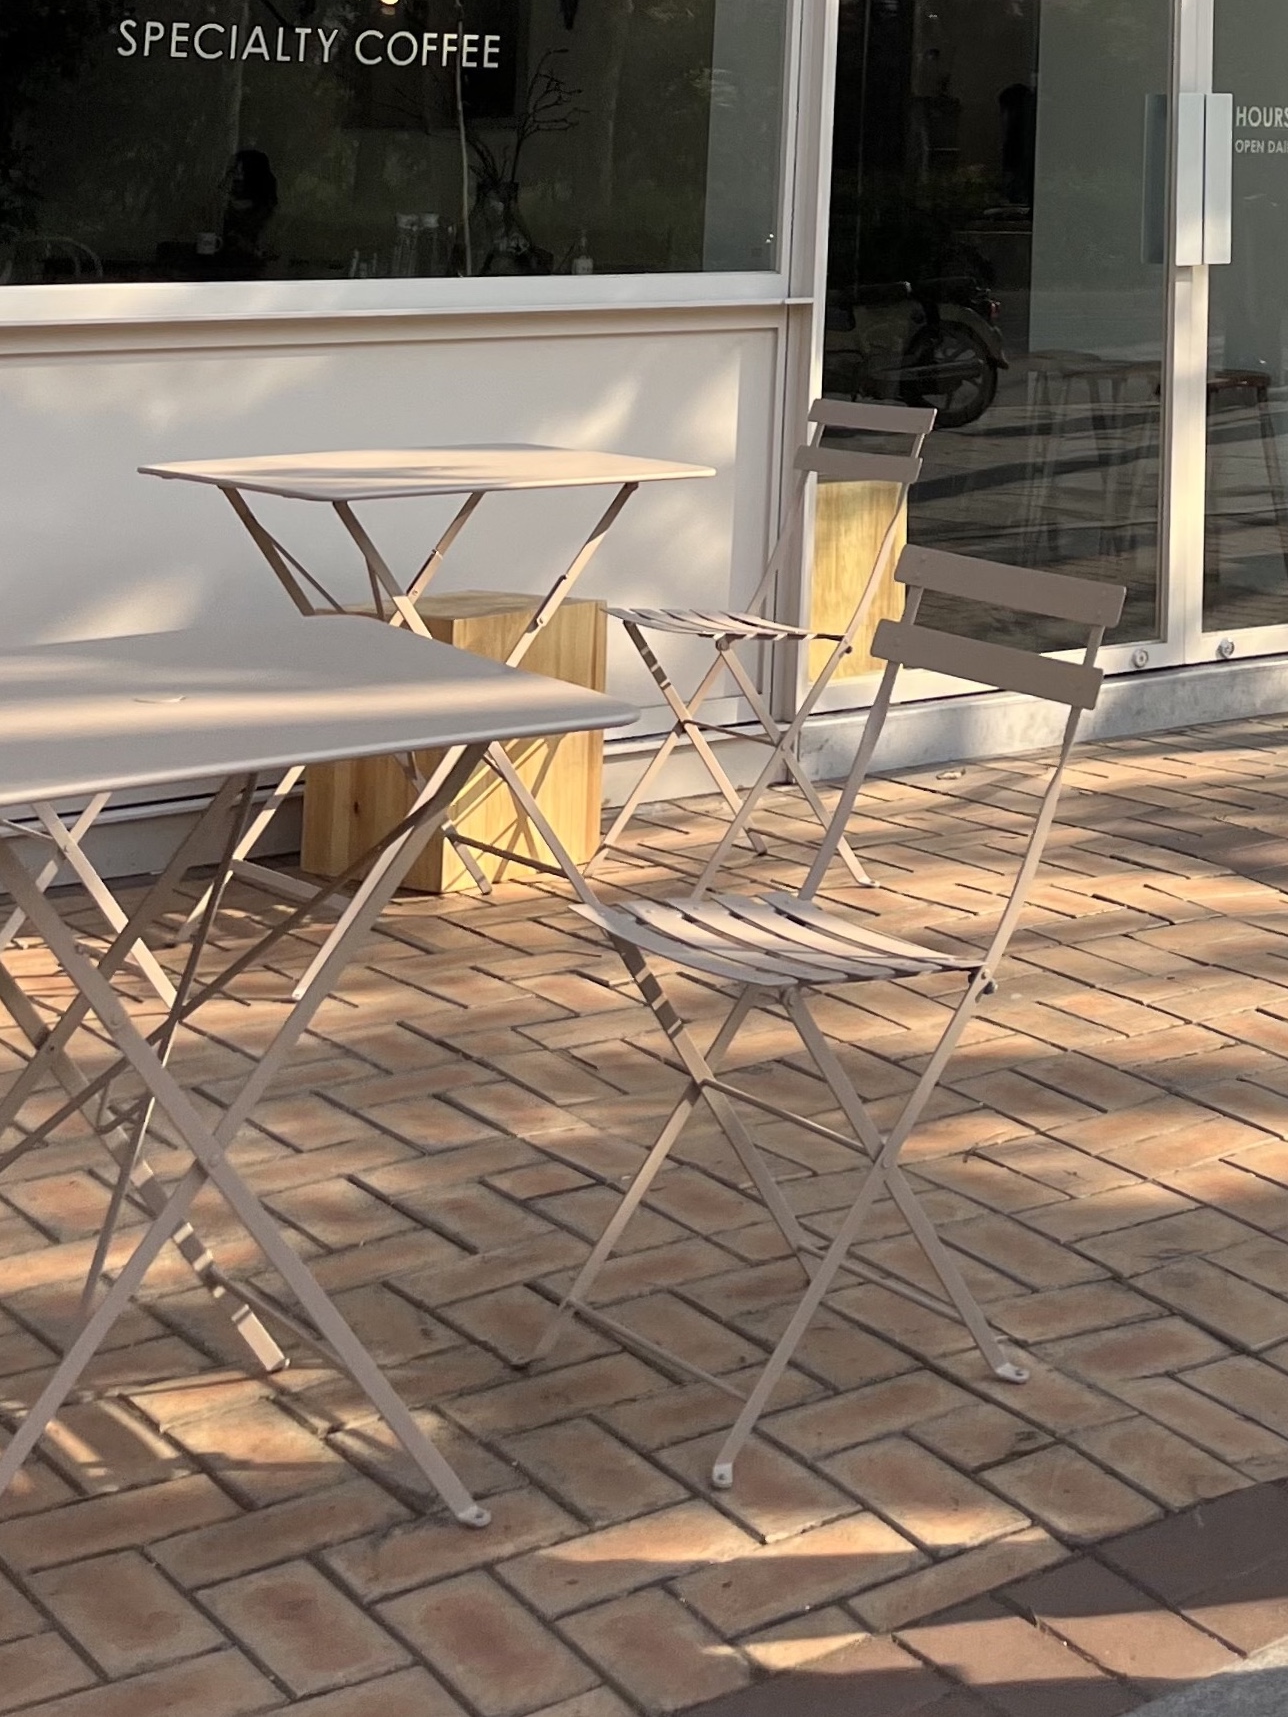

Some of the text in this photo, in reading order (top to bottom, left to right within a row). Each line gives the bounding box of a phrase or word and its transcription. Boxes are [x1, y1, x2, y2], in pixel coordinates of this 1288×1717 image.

[117, 19, 501, 68] SPECIALTY COFFEE
[1234, 139, 1265, 154] OPEN
